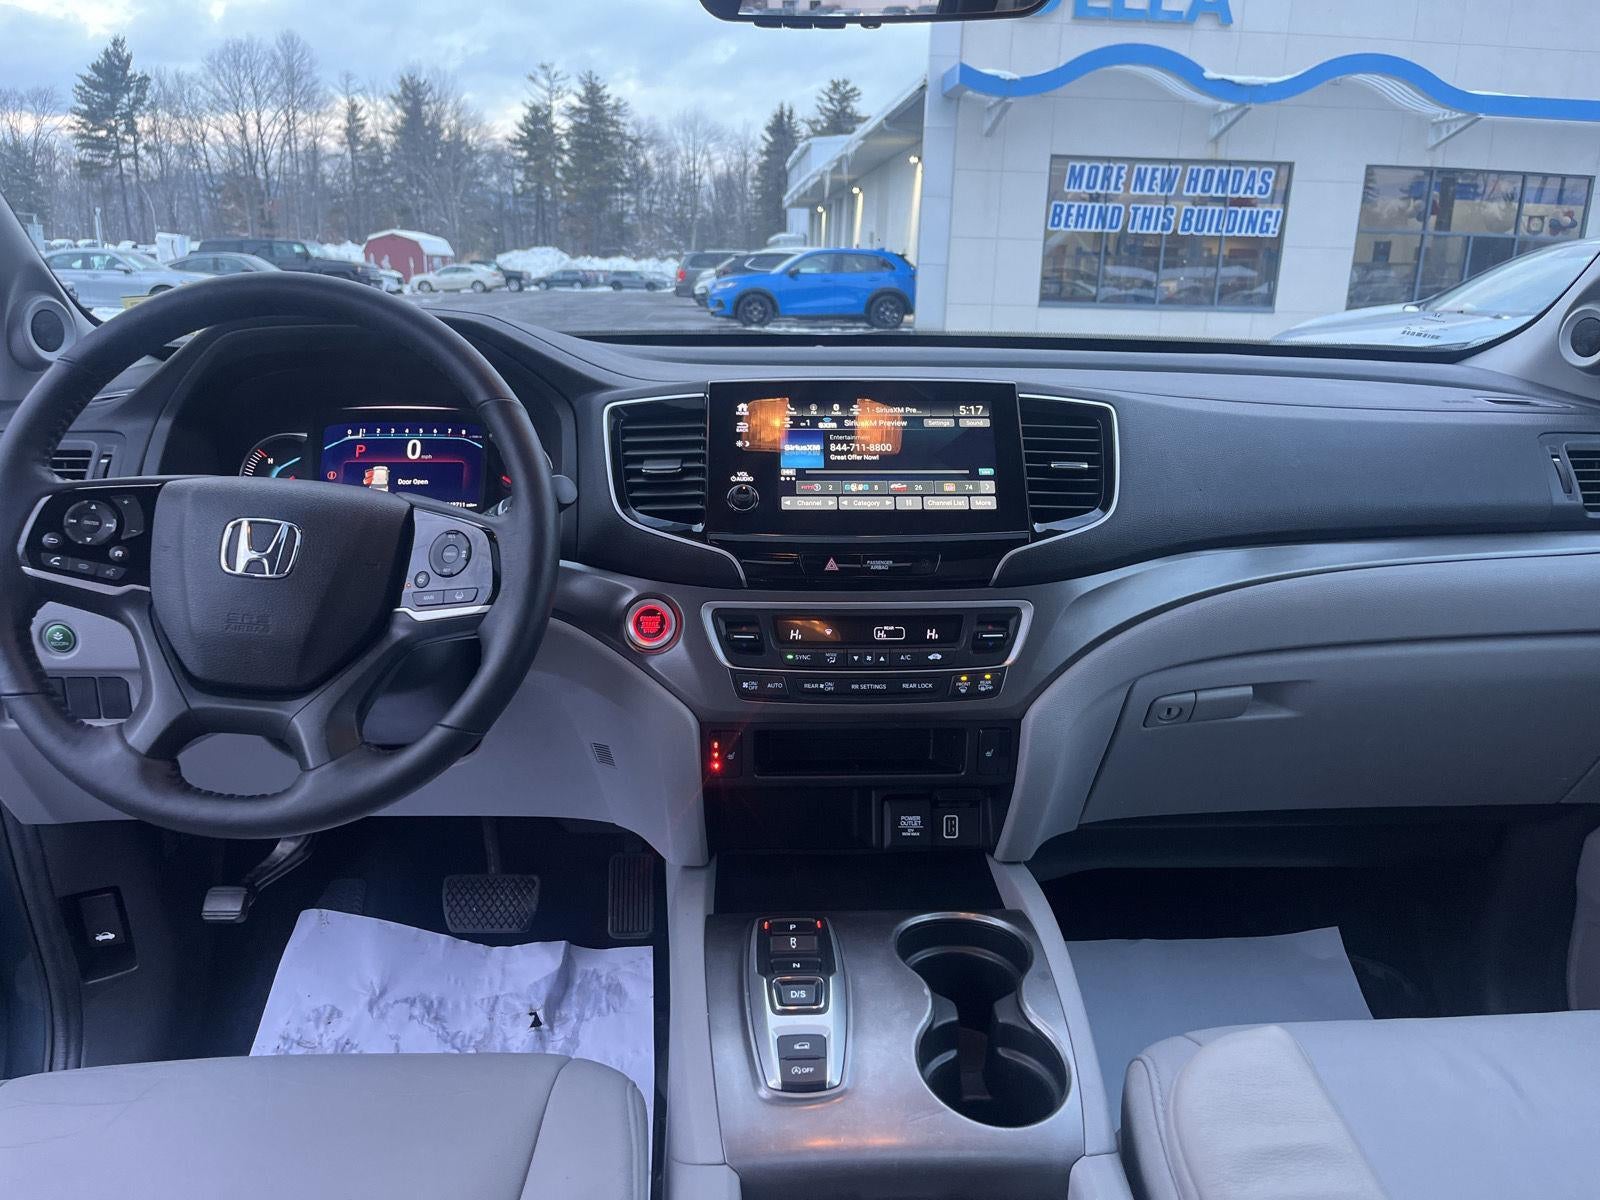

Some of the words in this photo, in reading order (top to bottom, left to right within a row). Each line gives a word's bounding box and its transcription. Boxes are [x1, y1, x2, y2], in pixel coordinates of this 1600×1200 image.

[1065, 163, 1126, 193] MORE
[1131, 166, 1180, 195] NEW
[1184, 167, 1275, 197] HONDAS
[1049, 202, 1123, 232] BEHIND
[1128, 204, 1176, 234] THIS
[1179, 206, 1283, 237] BUILDING!
[959, 405, 983, 415] 5:17
[355, 444, 366, 458] P
[406, 439, 421, 459] 0
[829, 443, 892, 452] 844-711-8800
[790, 990, 806, 998] D/S
